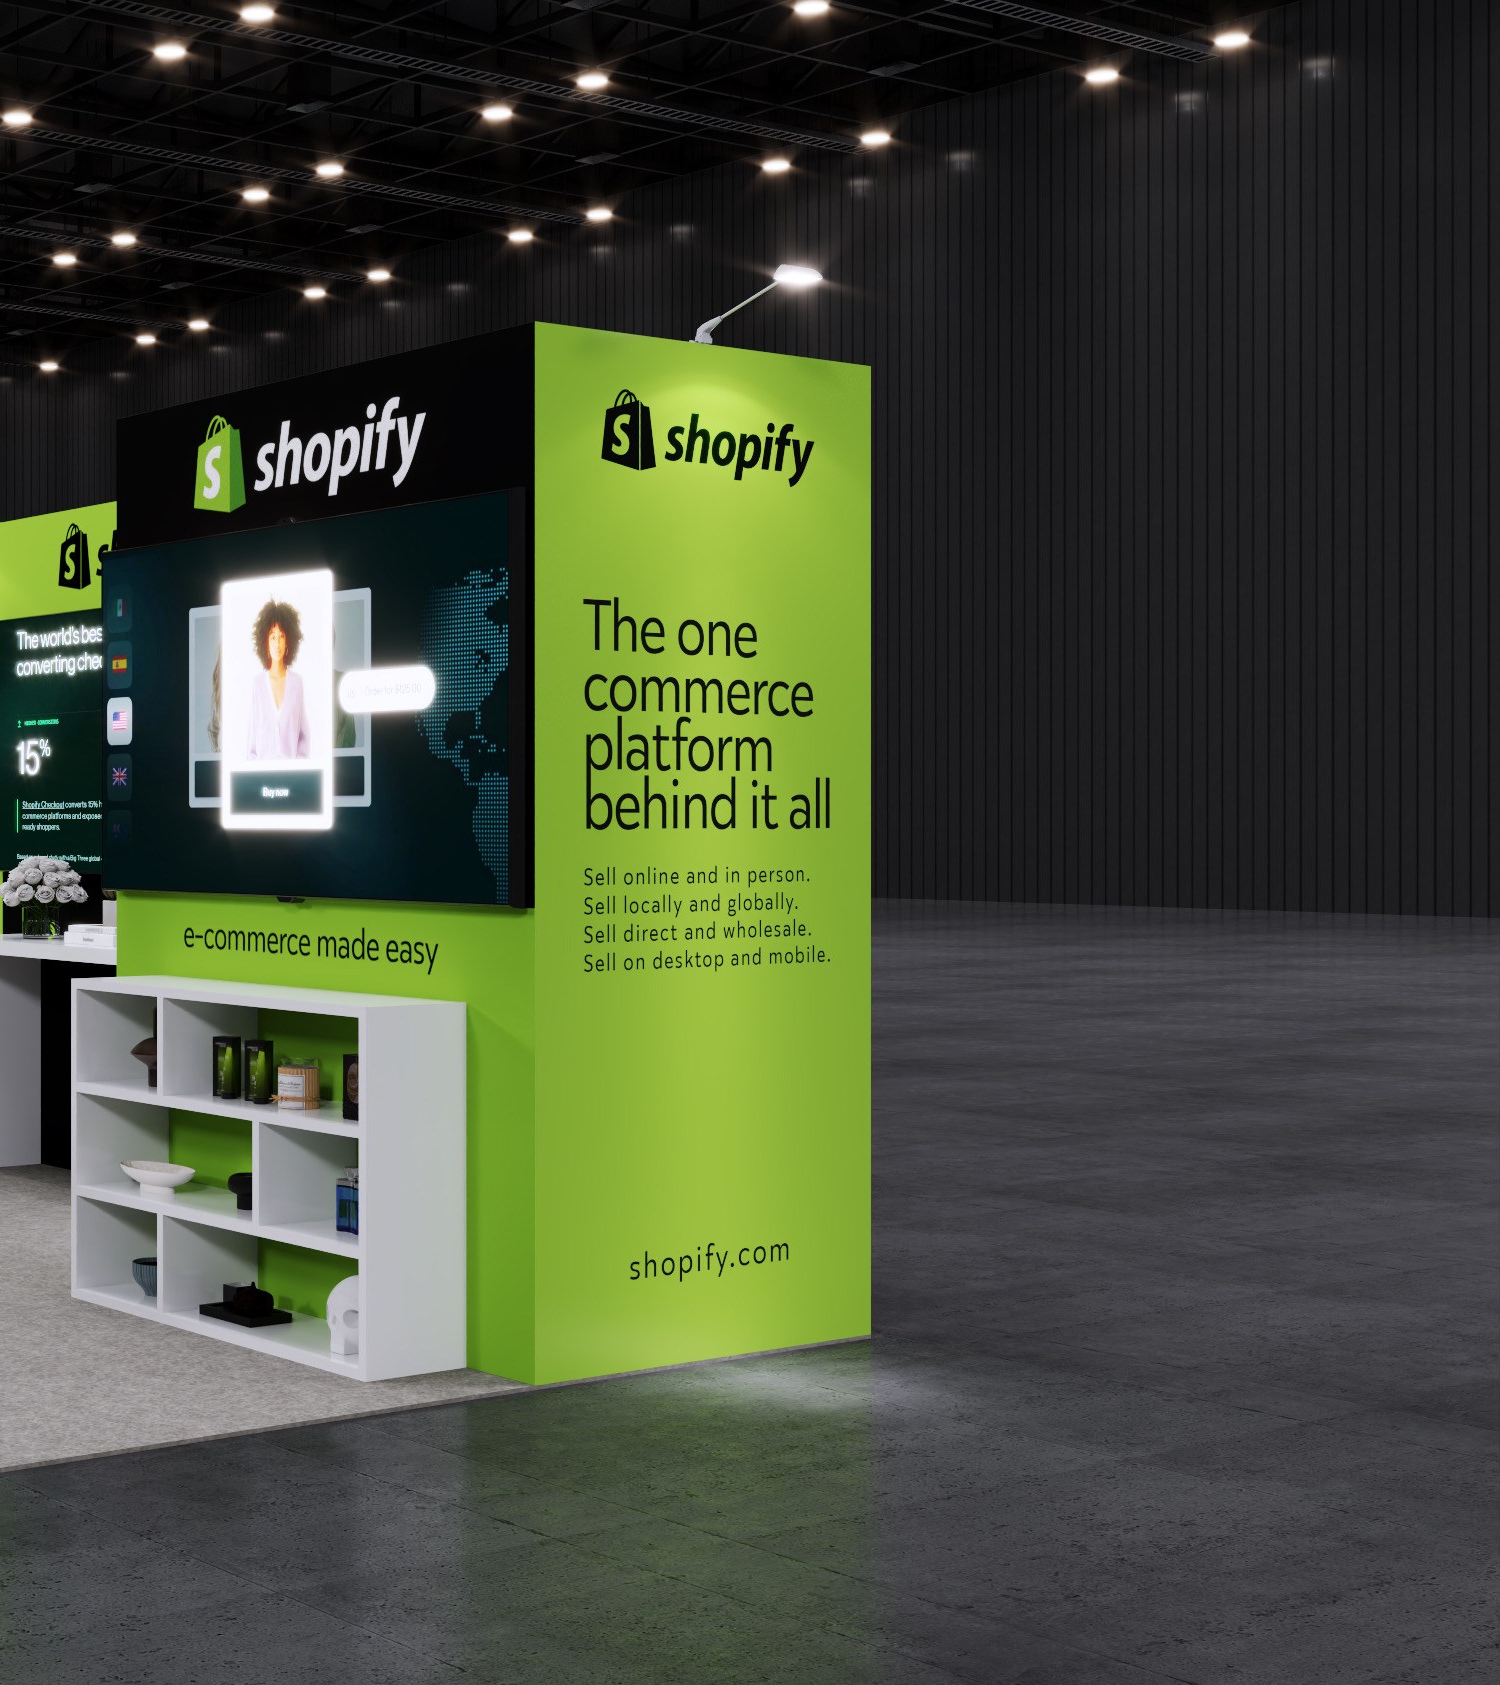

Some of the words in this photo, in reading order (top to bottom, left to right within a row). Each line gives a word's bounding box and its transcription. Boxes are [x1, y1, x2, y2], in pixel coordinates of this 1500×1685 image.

[254, 397, 426, 496] shopify
[665, 413, 815, 487] shopify
[16, 631, 39, 649] The
[40, 626, 80, 647] world's
[583, 597, 665, 654] The
[678, 620, 758, 658] one
[16, 655, 76, 676] converting
[584, 673, 814, 717] commerce
[17, 738, 51, 776] 15%
[586, 716, 773, 788] platform
[263, 787, 275, 798] Buy
[275, 788, 289, 797] now
[586, 776, 736, 830] behind
[752, 780, 778, 830] it
[789, 777, 831, 830] all
[583, 867, 616, 887] Sell
[623, 866, 678, 885] online
[687, 866, 718, 885] and
[725, 866, 740, 884] in
[747, 867, 810, 888] person.
[583, 895, 616, 916] Sell
[624, 894, 683, 918] locally
[689, 894, 721, 913] and
[727, 891, 799, 917] globally.
[183, 922, 311, 957] e-commerce
[317, 927, 379, 962] made
[385, 939, 439, 975] easy
[583, 924, 616, 944] Sell
[623, 923, 678, 943] direct
[684, 921, 716, 941] and
[723, 918, 812, 939] wholesale.
[583, 952, 616, 973] Sell
[623, 956, 646, 971] on
[652, 949, 725, 974] desktop
[730, 946, 762, 967] and
[769, 944, 831, 965] mobile.
[630, 1243, 789, 1282] shopify.com
